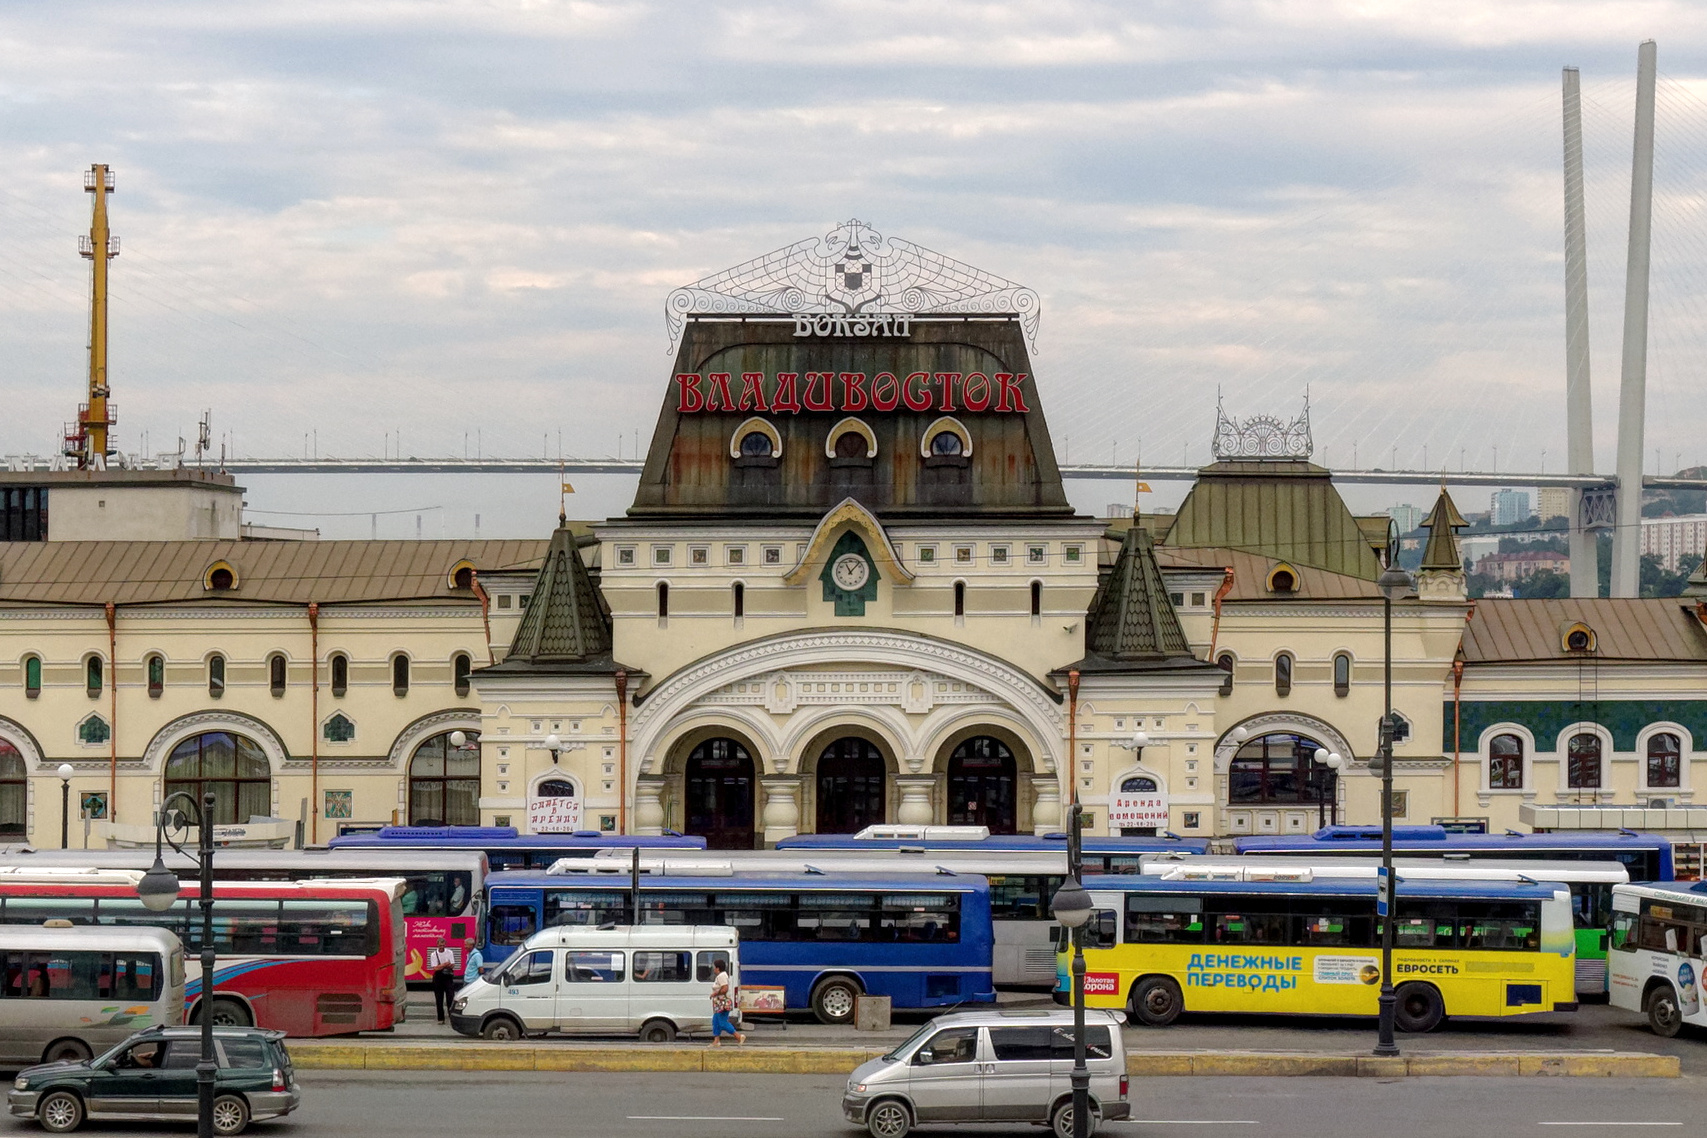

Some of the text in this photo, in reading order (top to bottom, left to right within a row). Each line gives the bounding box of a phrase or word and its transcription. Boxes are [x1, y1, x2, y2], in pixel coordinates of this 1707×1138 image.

[792, 313, 914, 337] ВОКЗАЛ
[675, 371, 1030, 415] ВЛАДИВОСТОК
[1187, 953, 1302, 971] ДЕНЕЖНЫЕ
[1396, 963, 1459, 975] ЕВРОСЕТЬ
[1084, 984, 1115, 992] орона
[1086, 976, 1115, 984] Золотая
[1187, 972, 1297, 993] ПЕРЕВОДЫ
